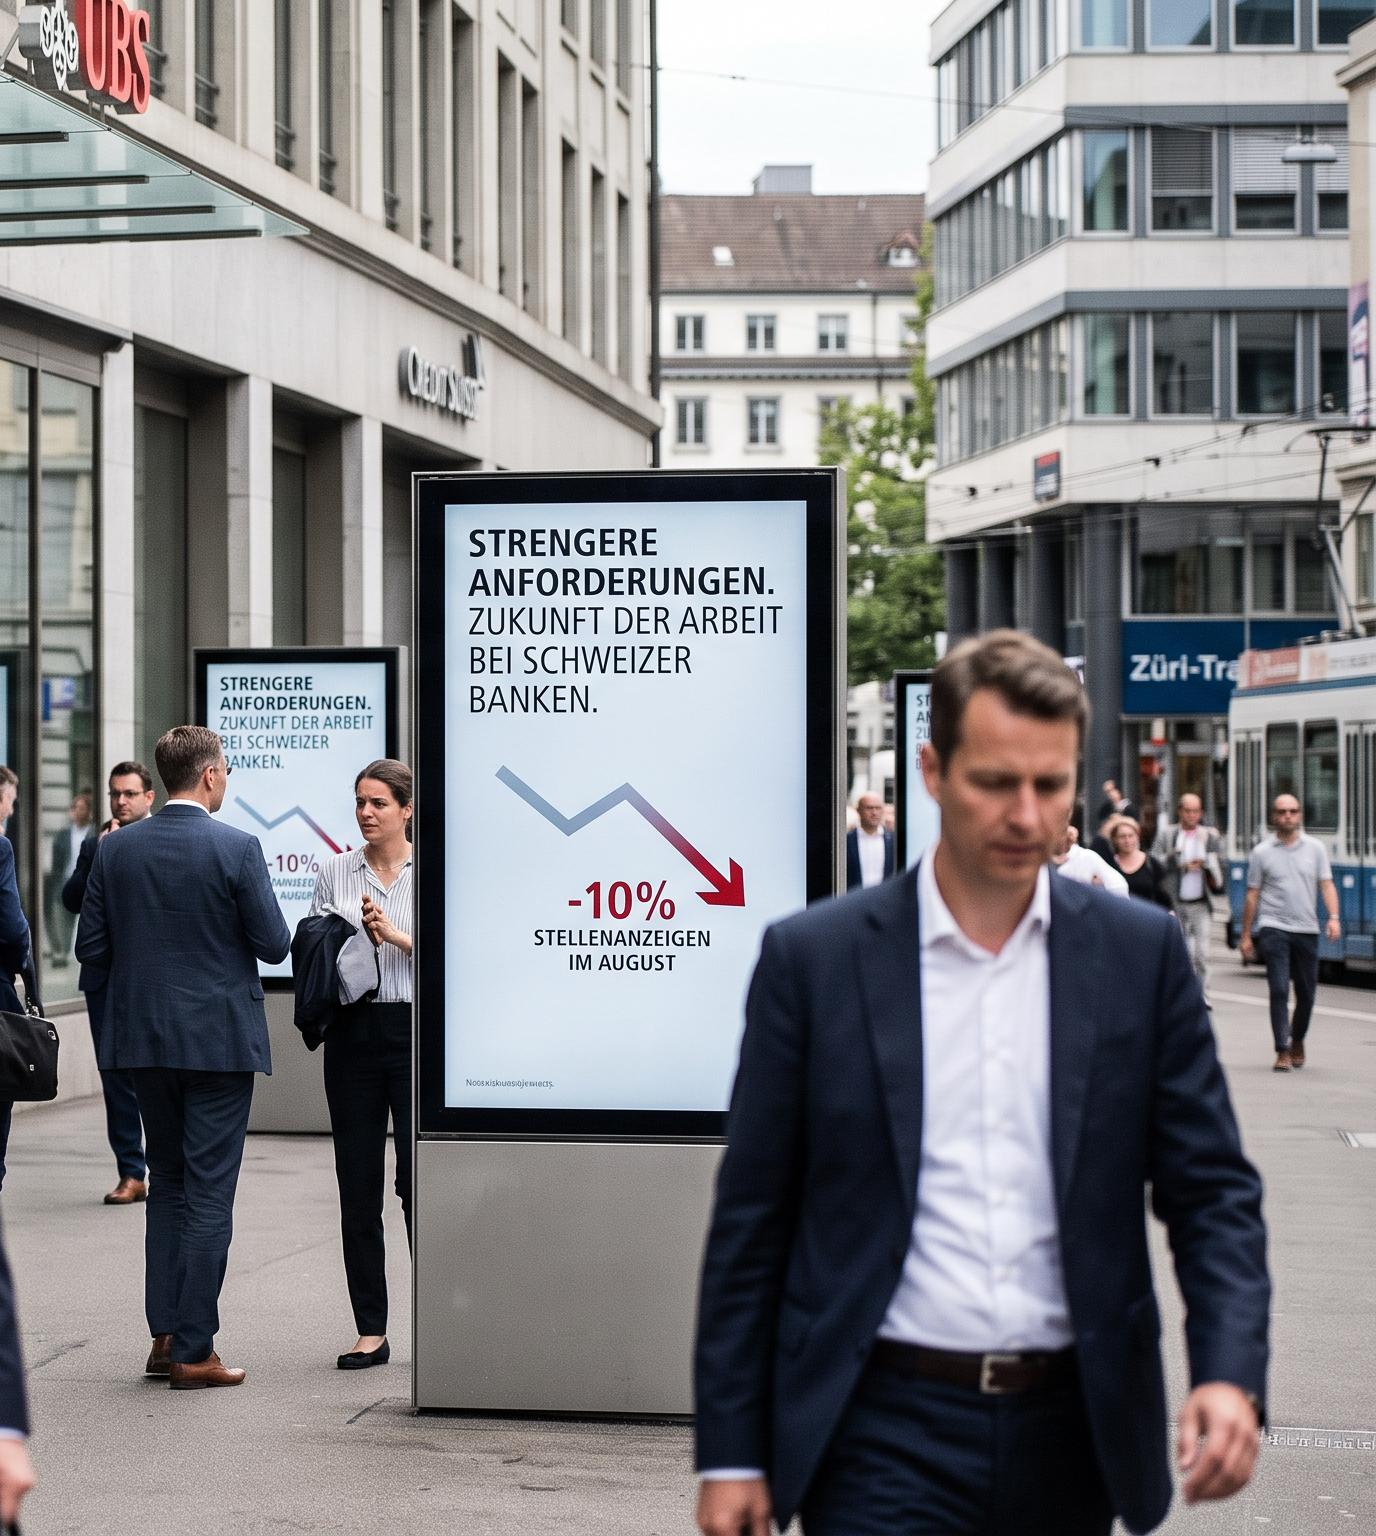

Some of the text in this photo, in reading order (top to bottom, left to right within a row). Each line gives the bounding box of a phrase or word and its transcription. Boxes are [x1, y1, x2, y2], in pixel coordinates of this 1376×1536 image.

[82, 0, 151, 114] UBS
[468, 527, 658, 559] STRENGERE
[467, 566, 775, 598] ANFORDERUNGEN.
[468, 605, 784, 636] ZUKUNFT DER ARBEIT
[469, 645, 693, 675] BEI SCHWEIZER
[220, 676, 314, 691] STRENGERE
[219, 695, 372, 711] ANFORDERUNGEN.
[469, 684, 598, 714] BANKEN.
[219, 715, 374, 730] ZUKUNFT DER ARBEIT
[222, 734, 330, 750] BEI SCHWEIZER
[267, 853, 320, 873] -10%
[567, 879, 676, 922] -10%
[533, 928, 711, 948] STELLENANZEIGEN
[569, 953, 677, 972] IM AUGUST
